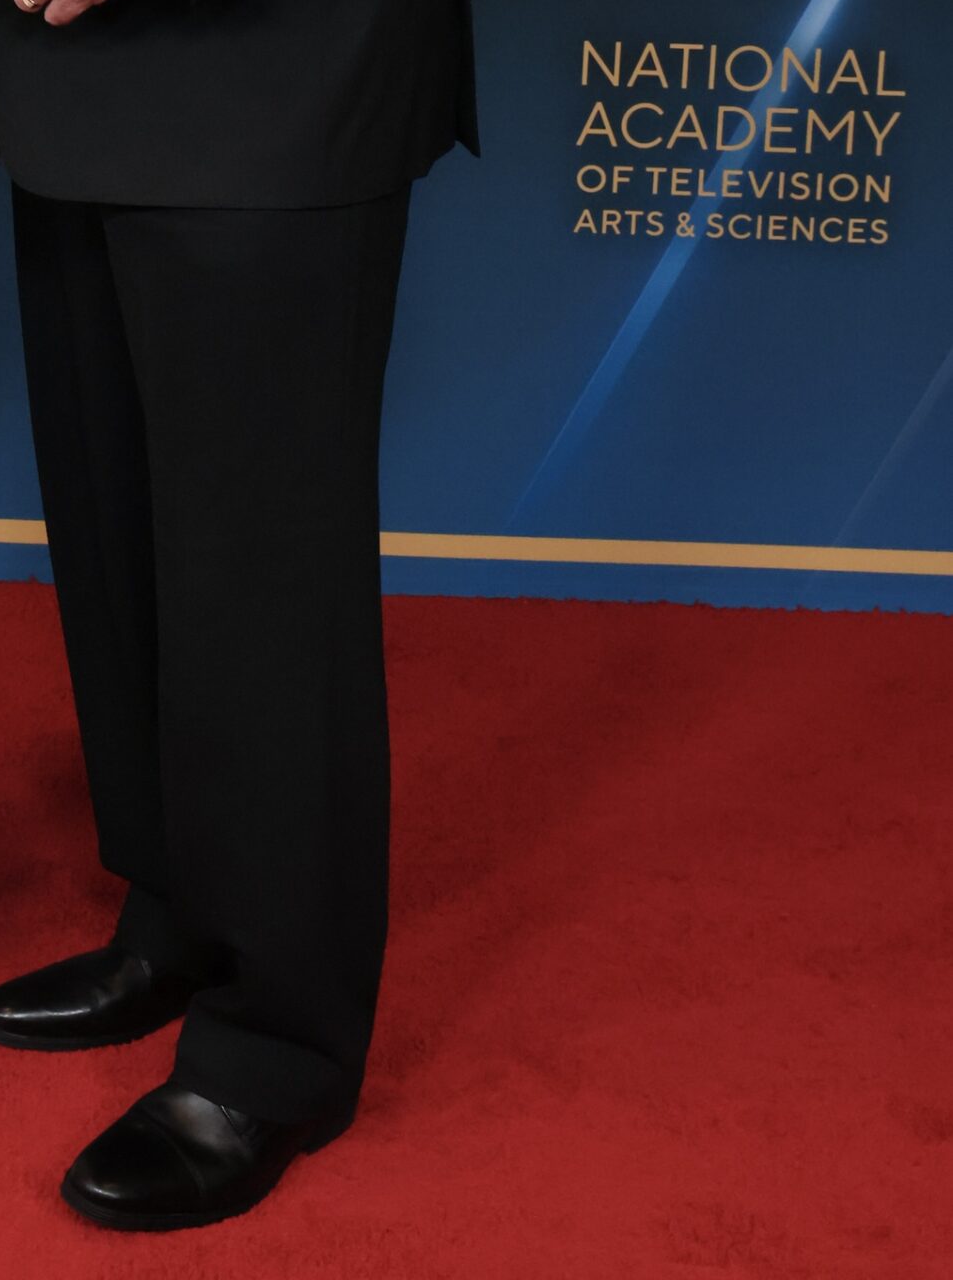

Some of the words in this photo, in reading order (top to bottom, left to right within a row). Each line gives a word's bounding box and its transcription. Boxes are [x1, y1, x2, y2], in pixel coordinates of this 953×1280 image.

[581, 40, 907, 98] NATIONAL
[575, 100, 902, 157] ACADEMY
[575, 164, 635, 194] OF
[645, 166, 892, 204] TELEVISION
[572, 207, 665, 238] ARTS
[674, 210, 697, 239] &
[705, 213, 890, 245] SCIENCES
